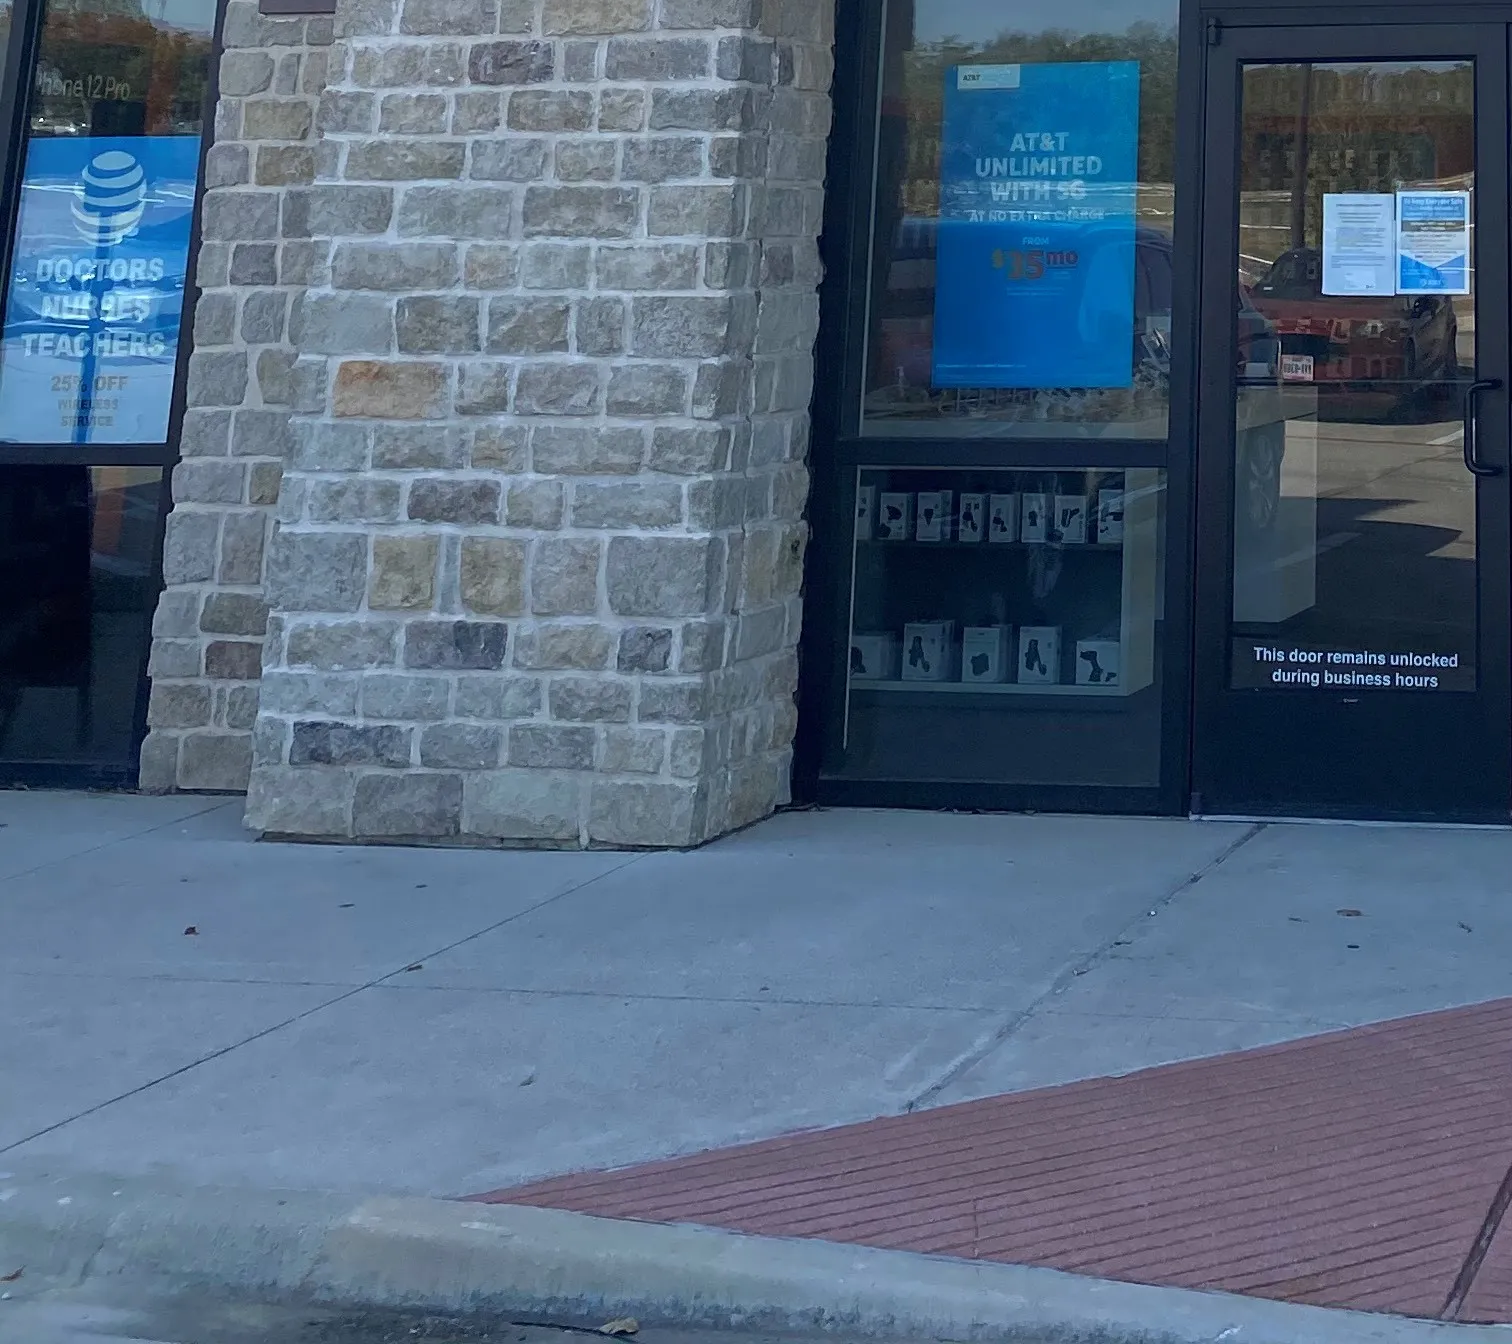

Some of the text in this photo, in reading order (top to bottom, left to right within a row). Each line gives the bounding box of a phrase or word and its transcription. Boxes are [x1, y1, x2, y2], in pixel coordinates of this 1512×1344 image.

[87, 75, 103, 100] 12
[1010, 132, 1069, 152] AT&T
[975, 156, 1103, 178] UNLIMITED
[990, 179, 1087, 201] WITH 5G
[988, 210, 1007, 222] NO
[36, 257, 165, 282] DOCTORS
[21, 332, 167, 358] TEACHERS
[94, 375, 129, 392] OFF
[1253, 646, 1459, 668] This door remains unlocked
[1271, 668, 1439, 688] during business hours
